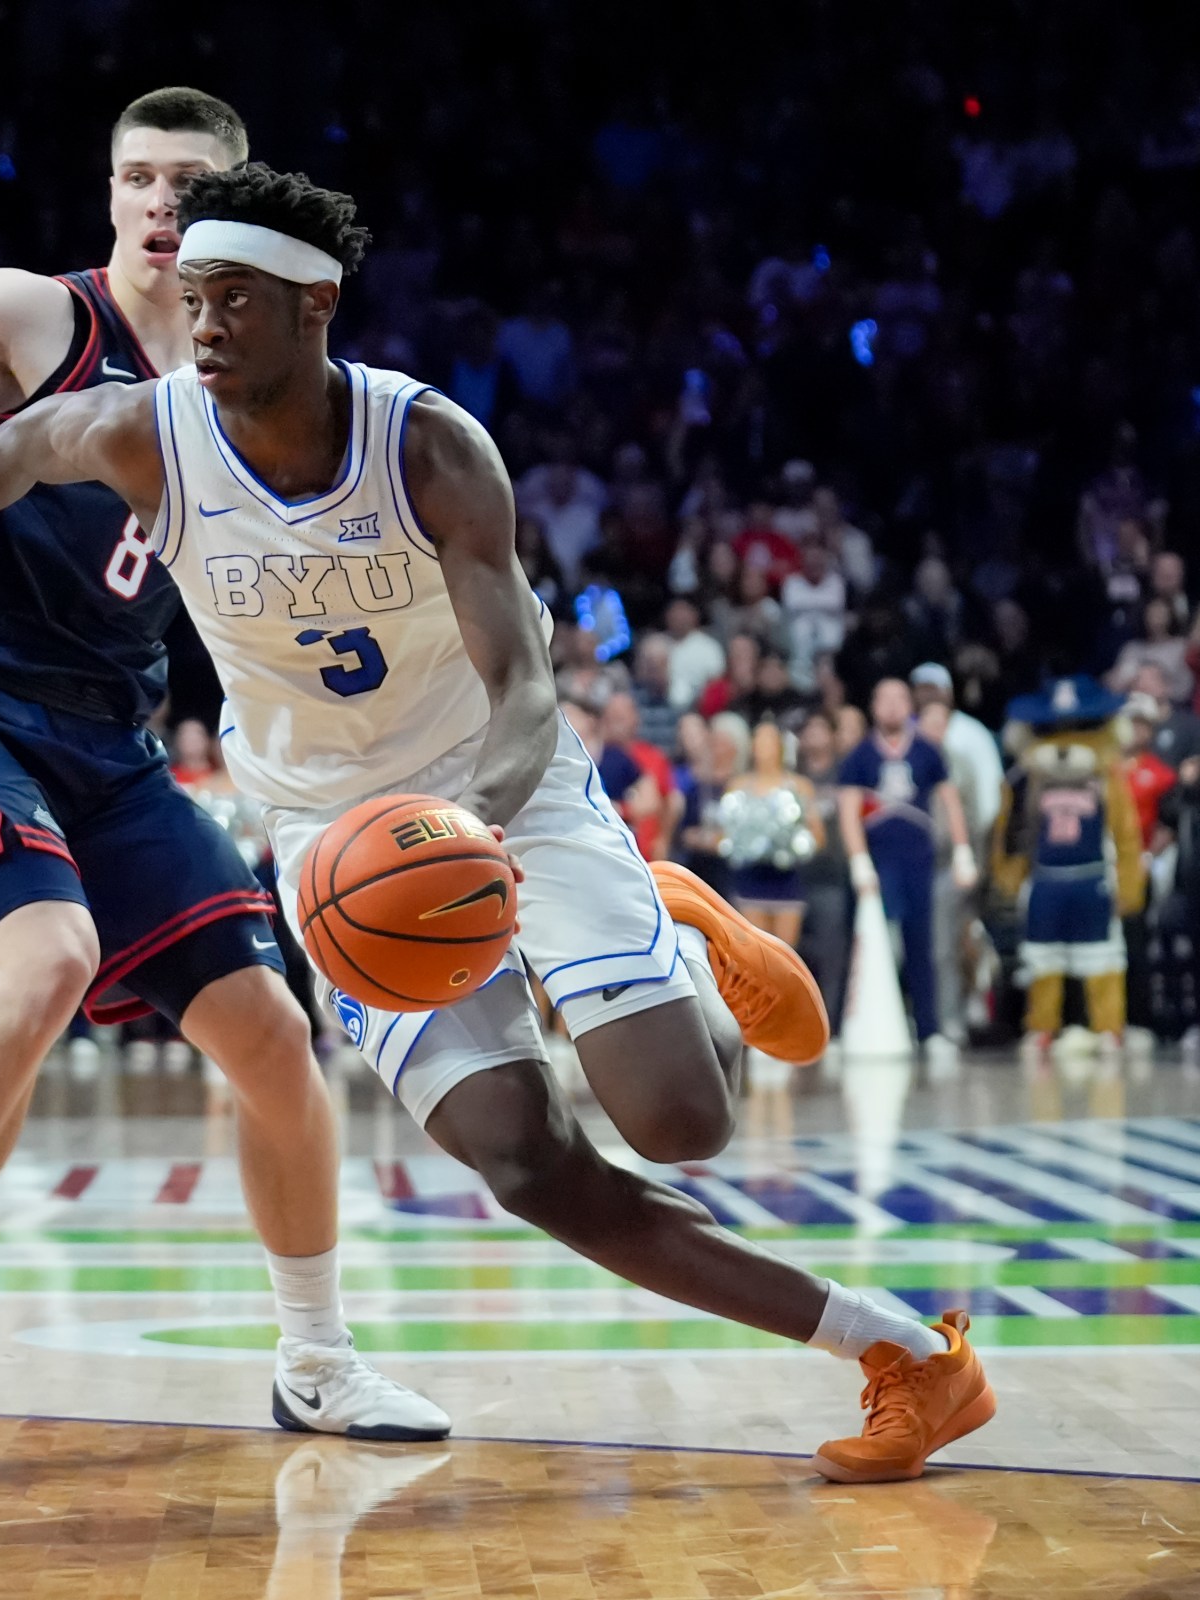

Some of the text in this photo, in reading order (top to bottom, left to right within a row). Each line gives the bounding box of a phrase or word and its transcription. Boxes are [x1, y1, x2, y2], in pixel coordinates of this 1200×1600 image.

[103, 512, 155, 601] 8
[206, 552, 414, 618] BYU
[294, 626, 389, 697] 3
